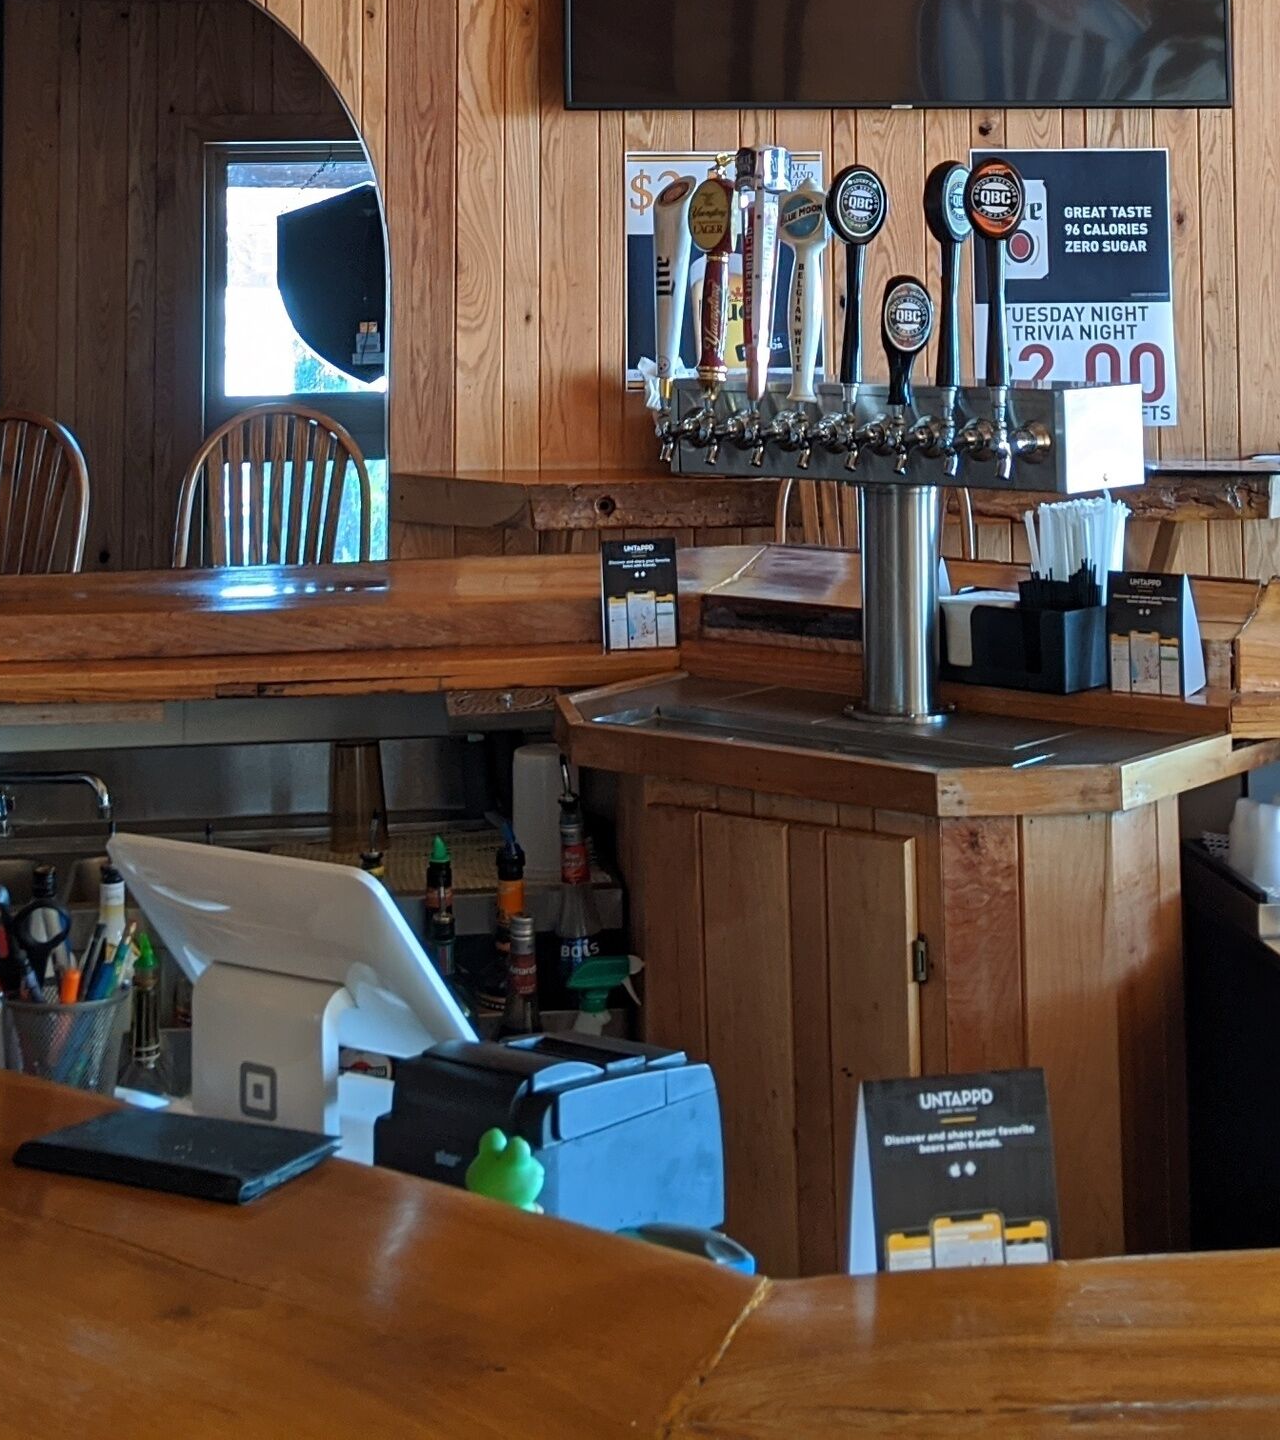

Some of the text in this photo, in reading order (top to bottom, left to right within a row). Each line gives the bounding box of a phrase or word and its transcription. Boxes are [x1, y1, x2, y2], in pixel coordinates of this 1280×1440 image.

[849, 196, 873, 210] QBC
[980, 190, 1011, 205] QBC
[1064, 206, 1152, 219] GREAT TASTE
[1064, 223, 1148, 236] 96 CALORIES
[1065, 240, 1147, 253] ZERO SUGAR
[794, 263, 805, 372] BELGIAN WHITE
[896, 309, 921, 322] QBC
[1091, 305, 1148, 322] NIGHT
[1012, 324, 1137, 341] TRIVIA NIGHT
[920, 1088, 993, 1109] UNTAPPD
[884, 1124, 1035, 1146] Discover and share your favorite
[919, 1143, 945, 1154] beers
[946, 1141, 967, 1152] with
